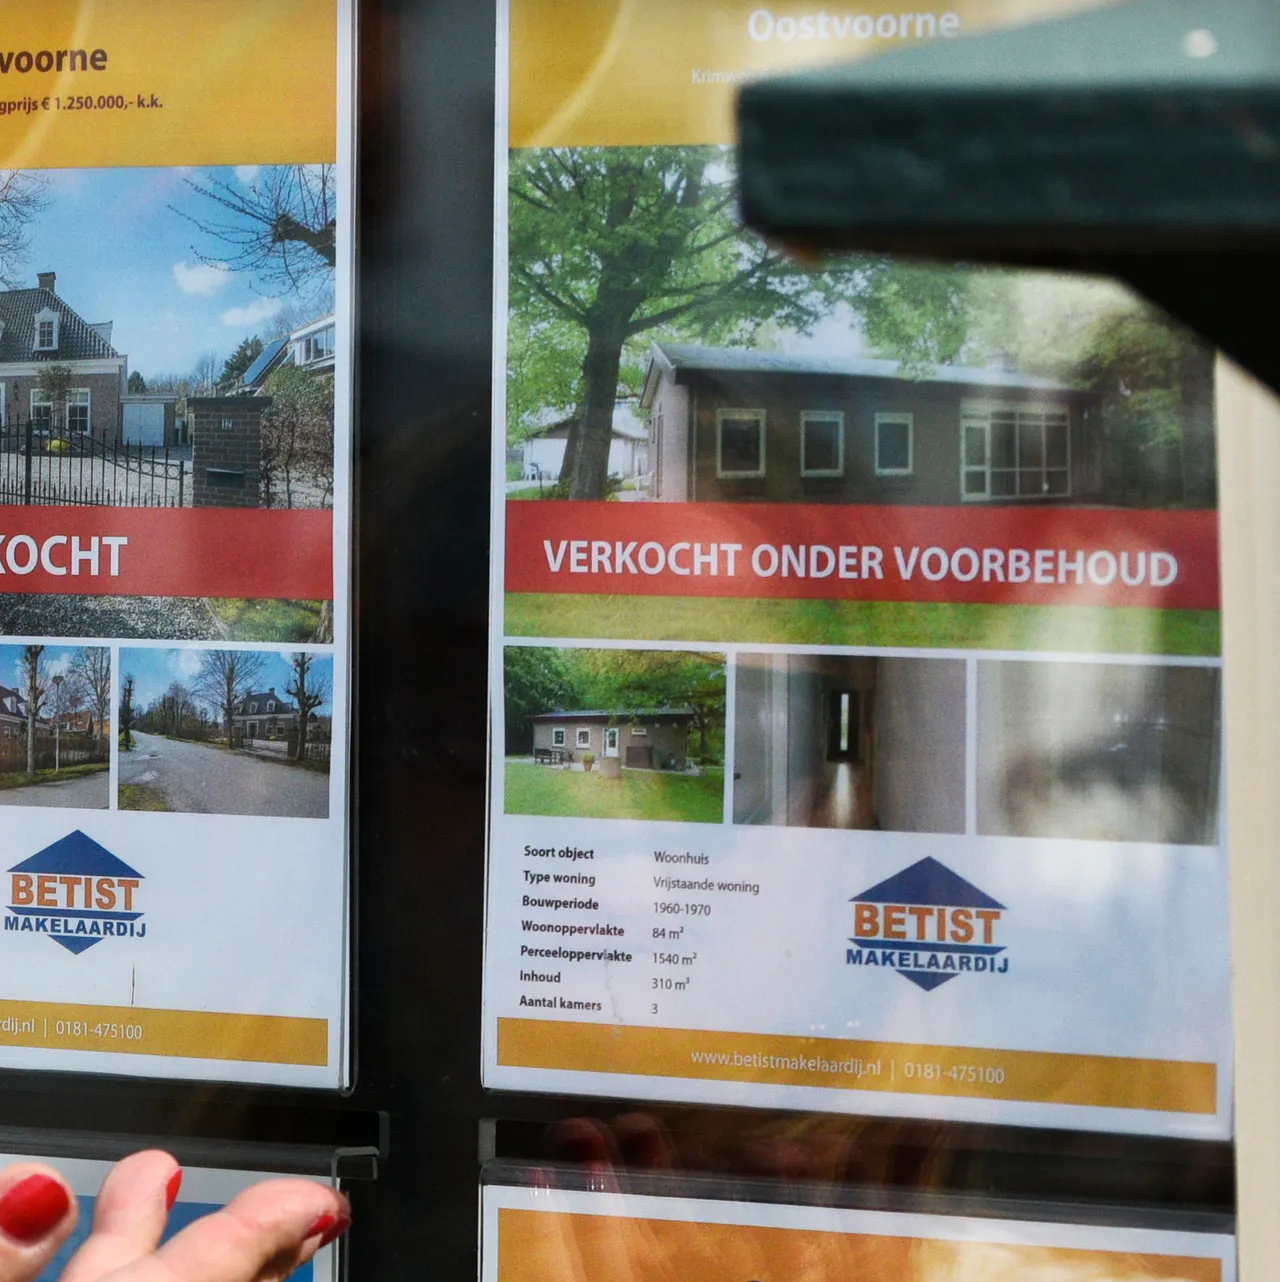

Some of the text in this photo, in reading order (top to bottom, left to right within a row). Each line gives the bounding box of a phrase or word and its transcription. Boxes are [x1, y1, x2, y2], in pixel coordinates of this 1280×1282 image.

[748, 9, 960, 41] Oostvoorne
[137, 94, 163, 108] k.k.
[543, 539, 1178, 588] VERKOCHT ONDER VOORBEHOUD
[524, 846, 709, 865] Soort object Woonhuis
[11, 874, 140, 910] BETIST
[524, 871, 759, 895] Type woning Vrijstaande woning
[522, 896, 711, 916] Bouwperiode 1960-1970
[4, 916, 146, 937] MAKELAARDIJ
[522, 921, 665, 938] Woonoppervlakte 84
[854, 904, 1001, 944] BETIST
[521, 946, 679, 964] Perceeloppervlakte 1540
[846, 948, 1009, 974] MAKELAARDIJ
[520, 970, 672, 990] Inhoud 310
[520, 995, 657, 1014] Aantal kamers 3
[56, 1021, 142, 1040] 0181-475100
[691, 1050, 1005, 1085] www.betistmakelaardij.nl 0181-475100
